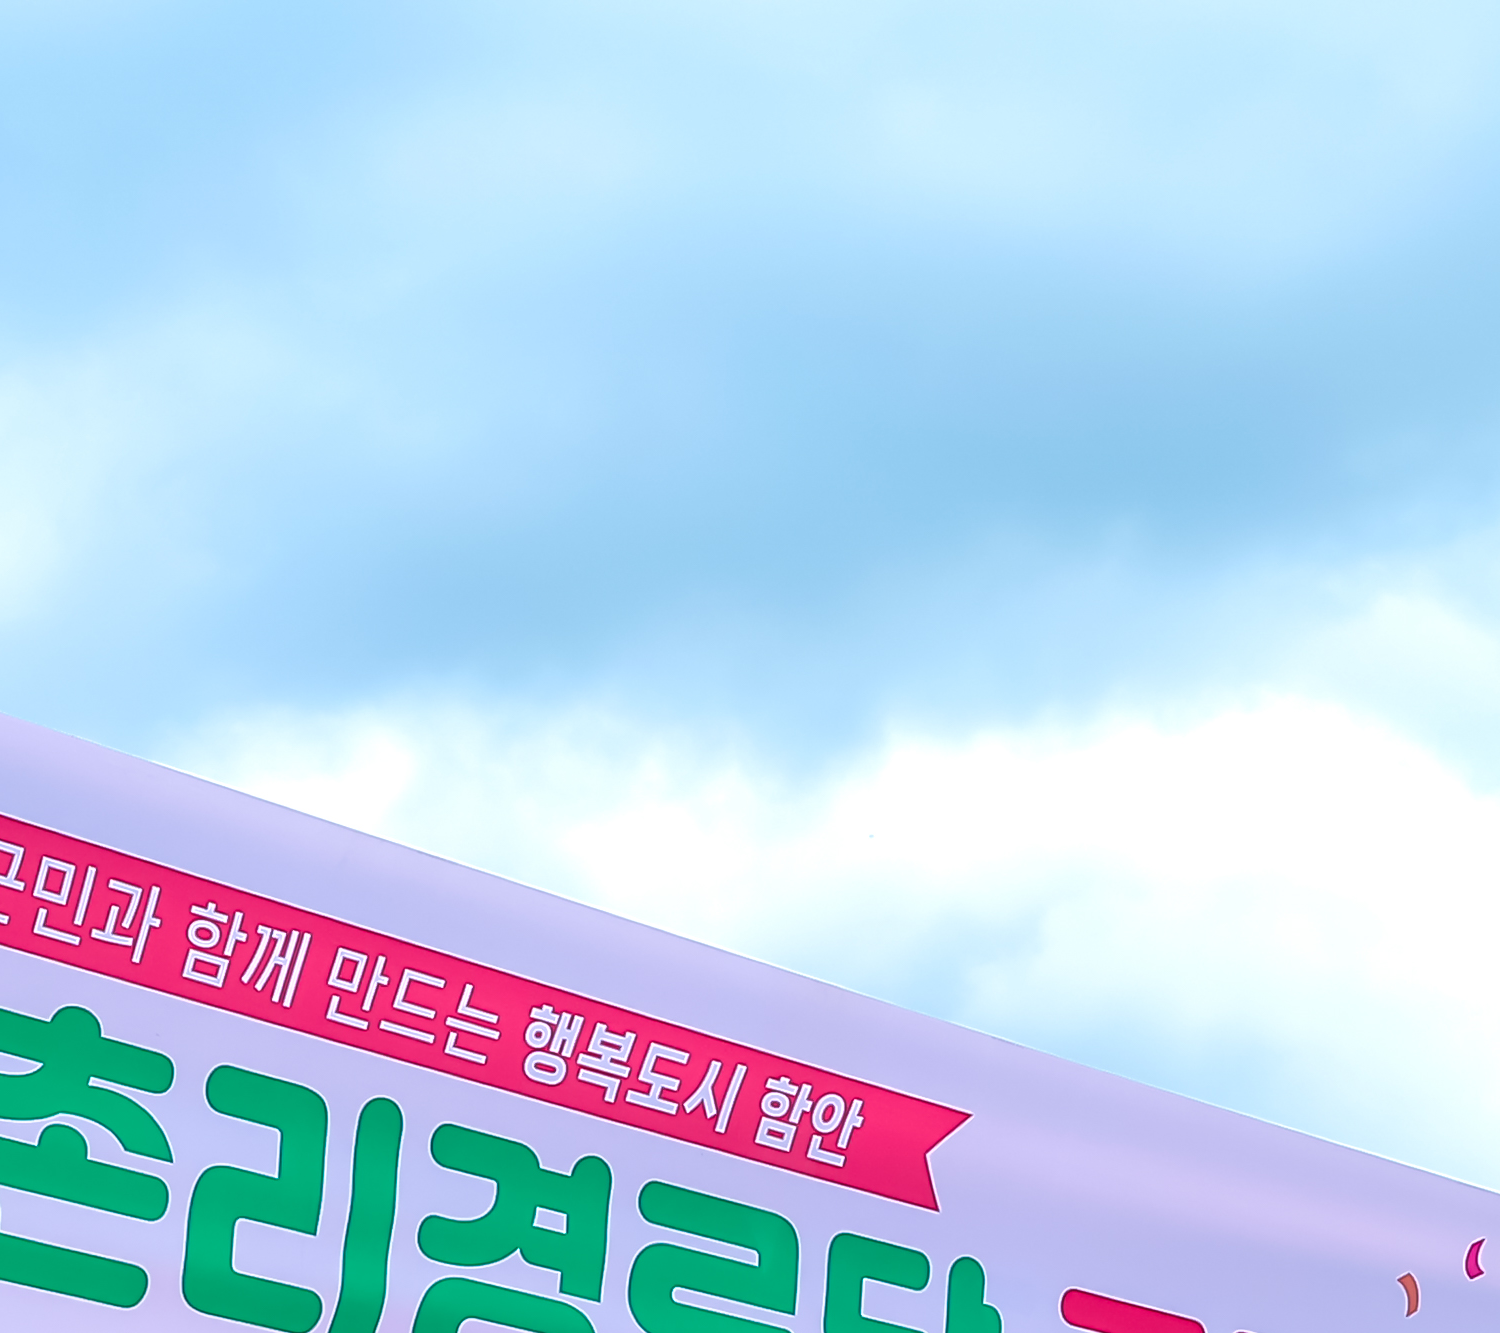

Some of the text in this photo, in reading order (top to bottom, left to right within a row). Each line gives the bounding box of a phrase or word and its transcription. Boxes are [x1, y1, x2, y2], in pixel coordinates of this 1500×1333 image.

[181, 901, 313, 1009] 함께
[325, 946, 501, 1065] 만드는
[522, 1003, 748, 1135] 행복도시
[753, 1075, 866, 1168] 함안
